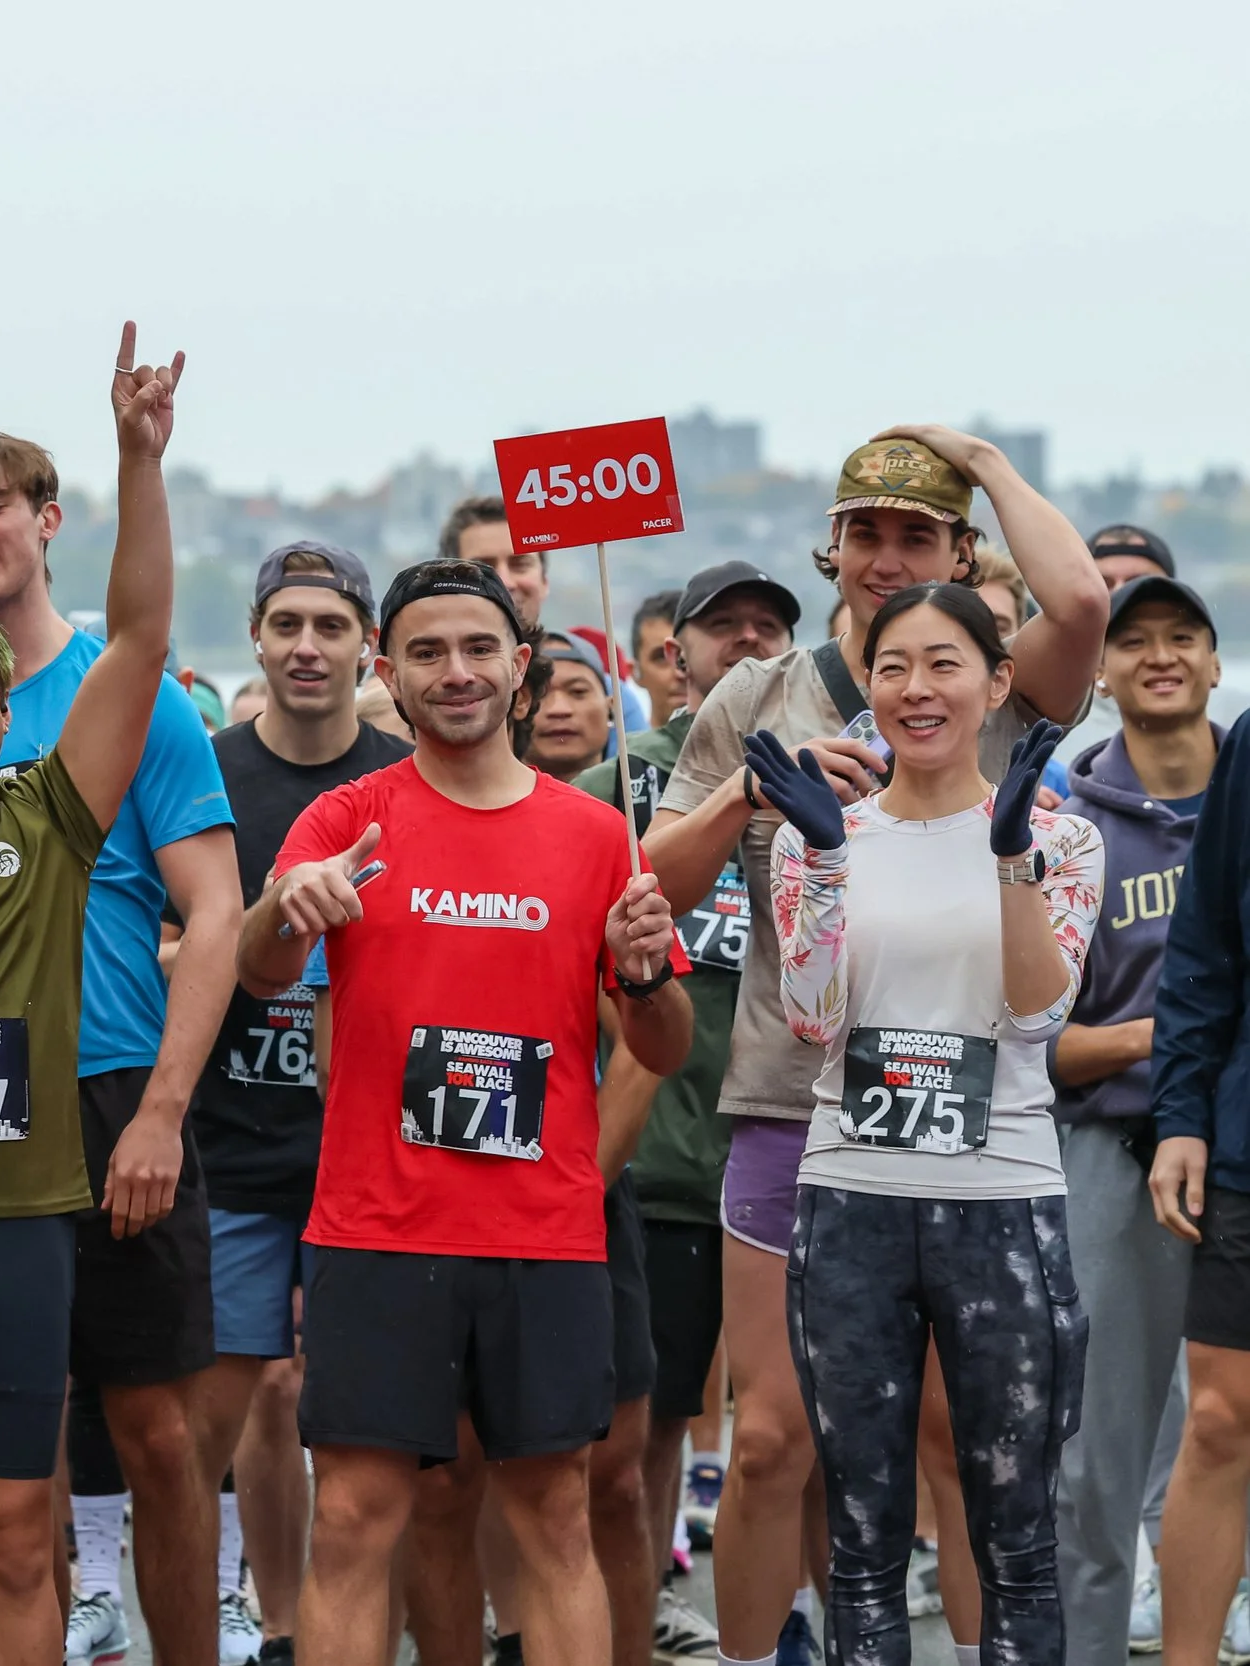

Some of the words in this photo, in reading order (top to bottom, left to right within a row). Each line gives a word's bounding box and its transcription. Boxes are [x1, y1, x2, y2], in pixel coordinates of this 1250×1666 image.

[515, 453, 661, 509] 45:00
[642, 517, 672, 529] PACER
[522, 533, 560, 545] KAMINO
[410, 887, 550, 931] KAMINO
[267, 1007, 314, 1019] SEAWA
[441, 1029, 523, 1050] VANCOUVER
[878, 1030, 964, 1049] VANCOUVER
[440, 1041, 454, 1053] IS
[454, 1042, 522, 1061] AWESOME
[878, 1041, 892, 1053] IS
[892, 1043, 963, 1060] AWESOME
[446, 1061, 513, 1080] SEAWALL
[883, 1062, 953, 1078] SEAWALL
[446, 1072, 475, 1087] 10K
[475, 1076, 513, 1092] RACE
[912, 1076, 952, 1090] RACE
[427, 1086, 517, 1144] 171
[858, 1086, 966, 1142] 275
